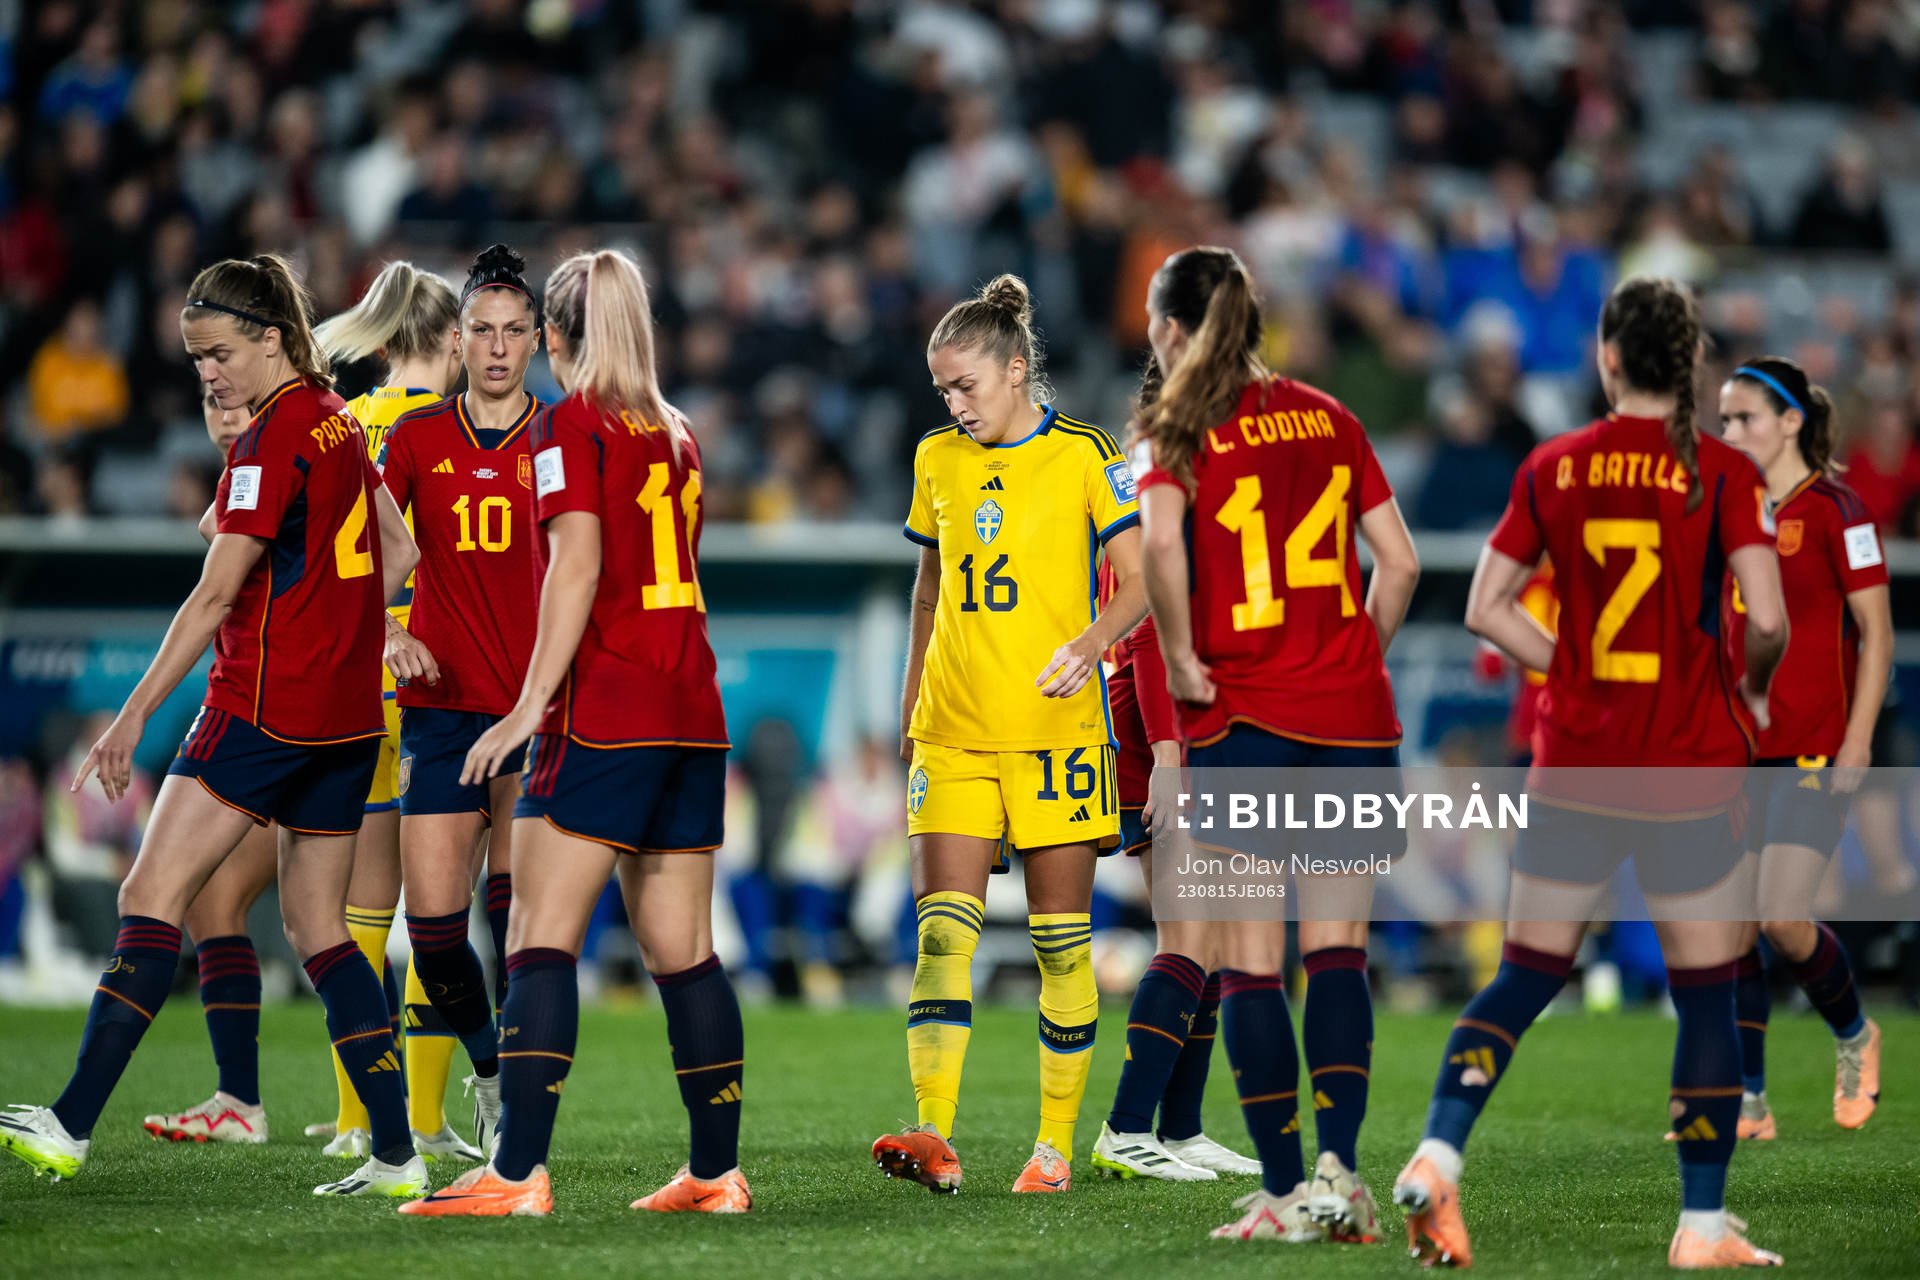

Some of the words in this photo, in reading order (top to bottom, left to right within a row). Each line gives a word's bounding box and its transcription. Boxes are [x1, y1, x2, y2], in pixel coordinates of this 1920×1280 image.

[1207, 427, 1236, 454] L.
[1238, 409, 1336, 447] CODINA
[1587, 451, 1689, 494] BATLLE
[451, 495, 512, 552] 10
[635, 462, 707, 613] 11
[1214, 465, 1358, 632] 14
[958, 554, 1018, 612] 16
[1582, 518, 1662, 683] 2
[1036, 748, 1096, 801] 16
